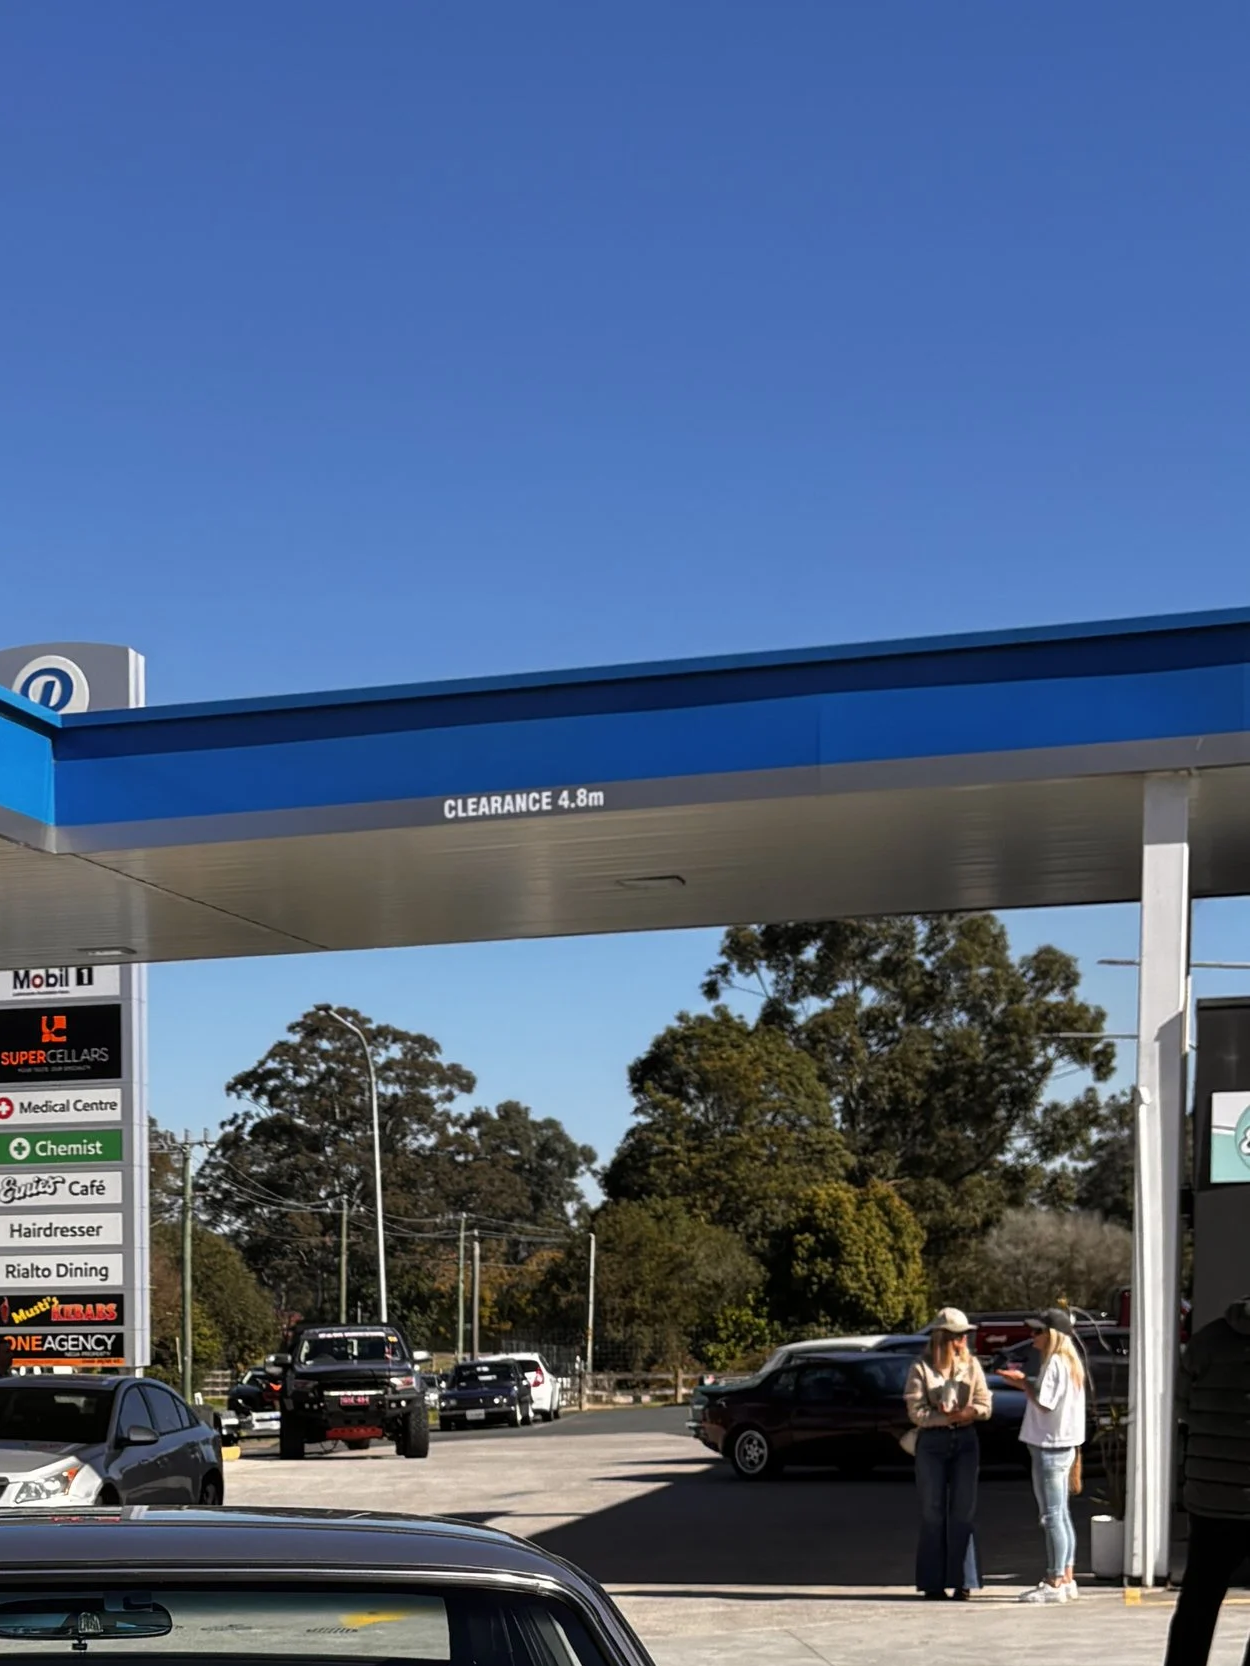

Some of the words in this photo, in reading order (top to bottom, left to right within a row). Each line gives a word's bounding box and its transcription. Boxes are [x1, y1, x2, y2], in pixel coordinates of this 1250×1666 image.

[443, 791, 553, 819] CLEARANCE
[557, 787, 604, 809] 4.8m
[12, 967, 69, 989] Mobil
[0, 1047, 110, 1066] SUPERCELLARS
[19, 1099, 70, 1114] Medical
[73, 1098, 118, 1112] Centre
[35, 1139, 103, 1157] Chemist
[68, 1178, 106, 1196] Café
[9, 1222, 103, 1239] Hairdresser
[5, 1263, 52, 1279] Rialto
[56, 1262, 109, 1282] Dining
[11, 1296, 60, 1325] Musti's
[51, 1302, 117, 1322] KEBABS
